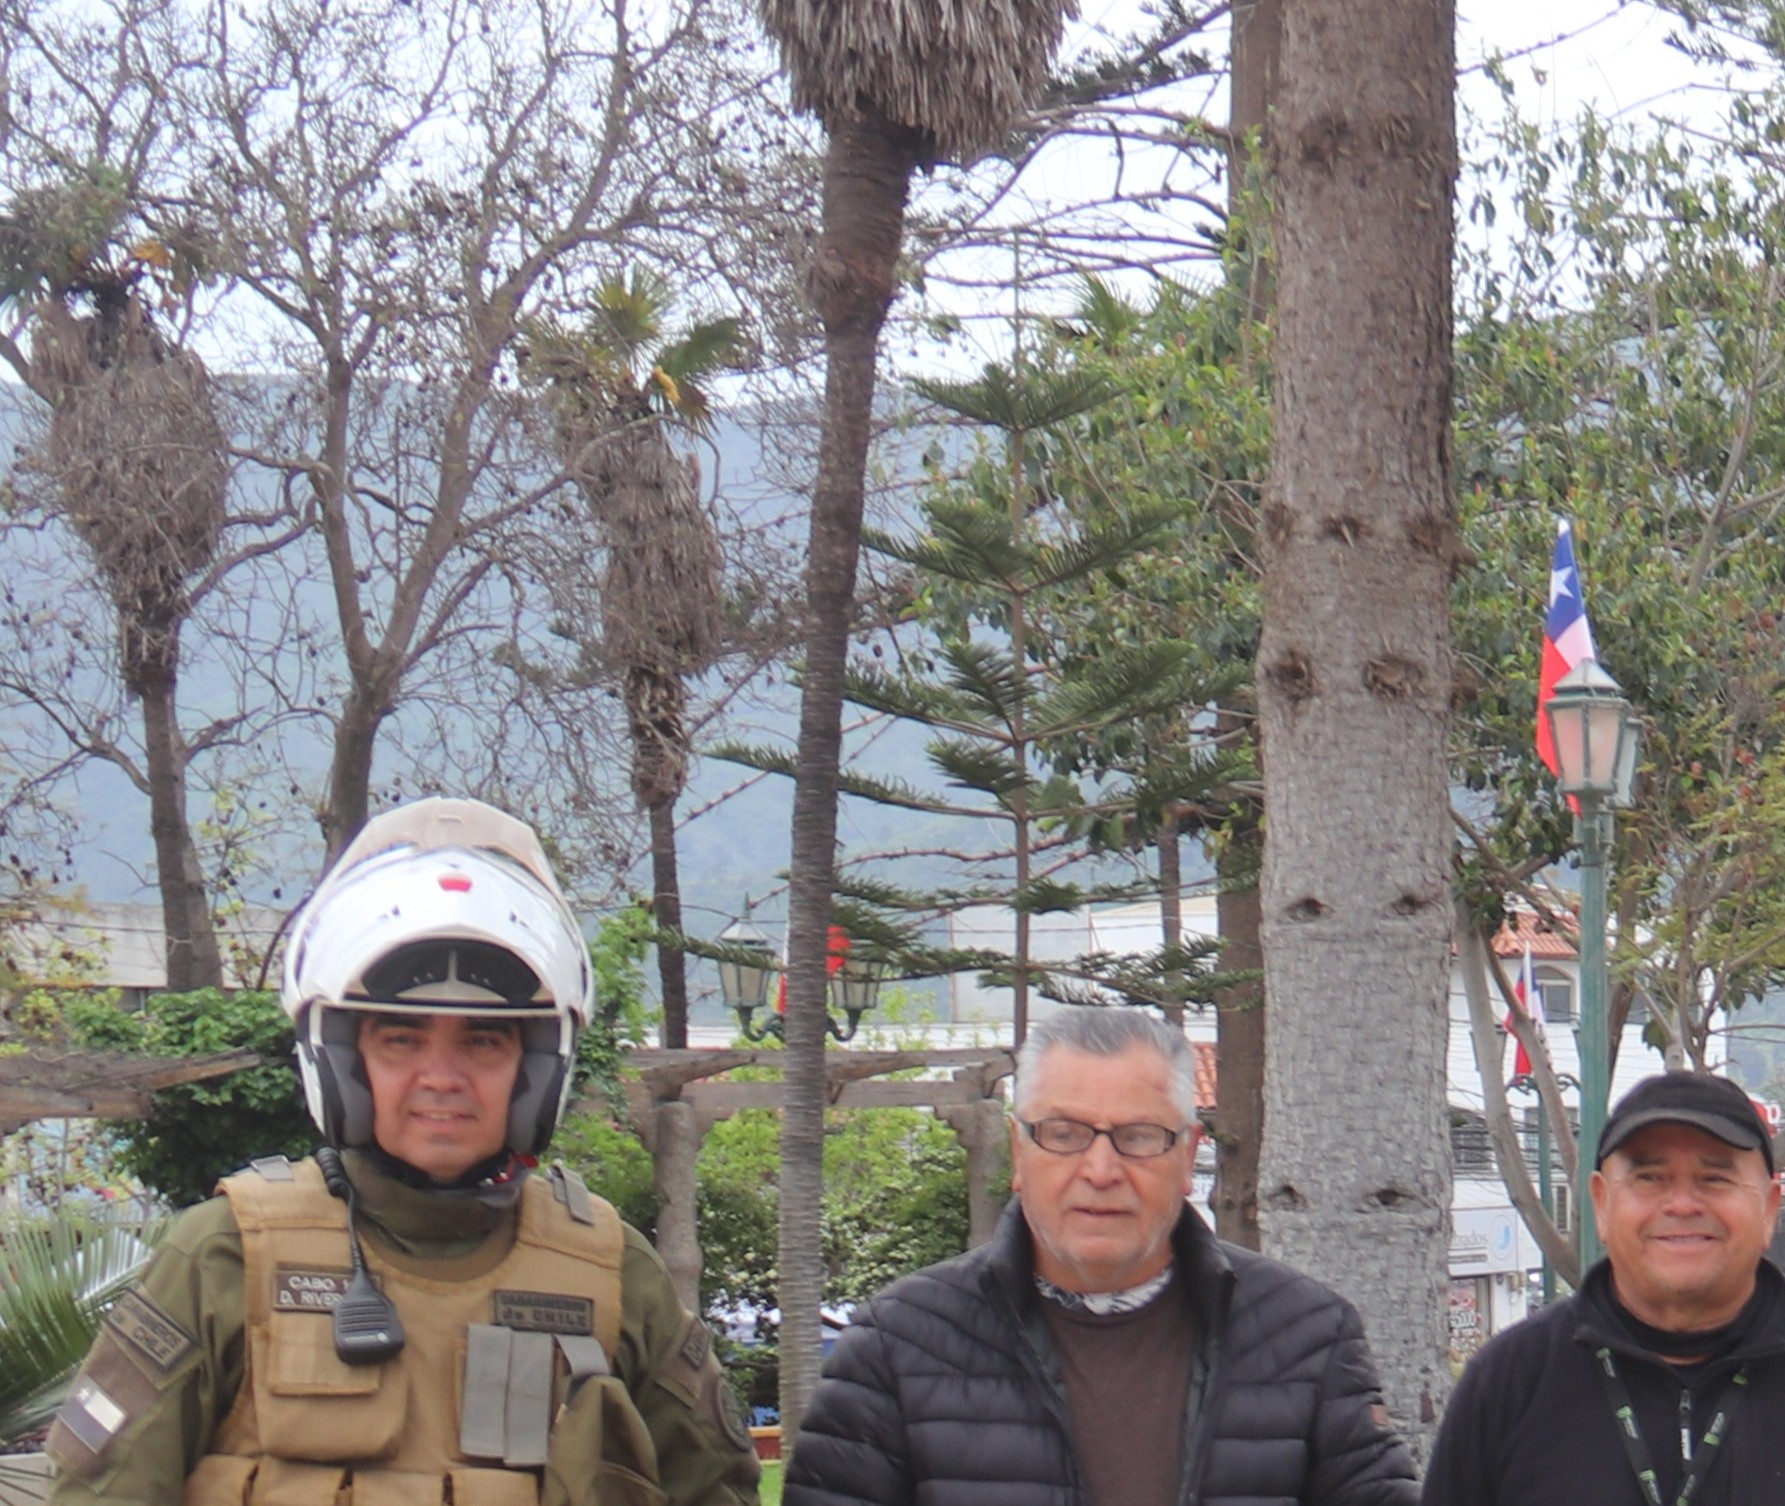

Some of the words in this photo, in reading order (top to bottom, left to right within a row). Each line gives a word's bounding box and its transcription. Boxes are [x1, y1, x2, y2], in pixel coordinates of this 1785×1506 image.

[288, 1276, 337, 1291] CABO
[502, 1306, 524, 1321] de
[533, 1309, 587, 1327] CHILE
[132, 1326, 171, 1360] CHILE
